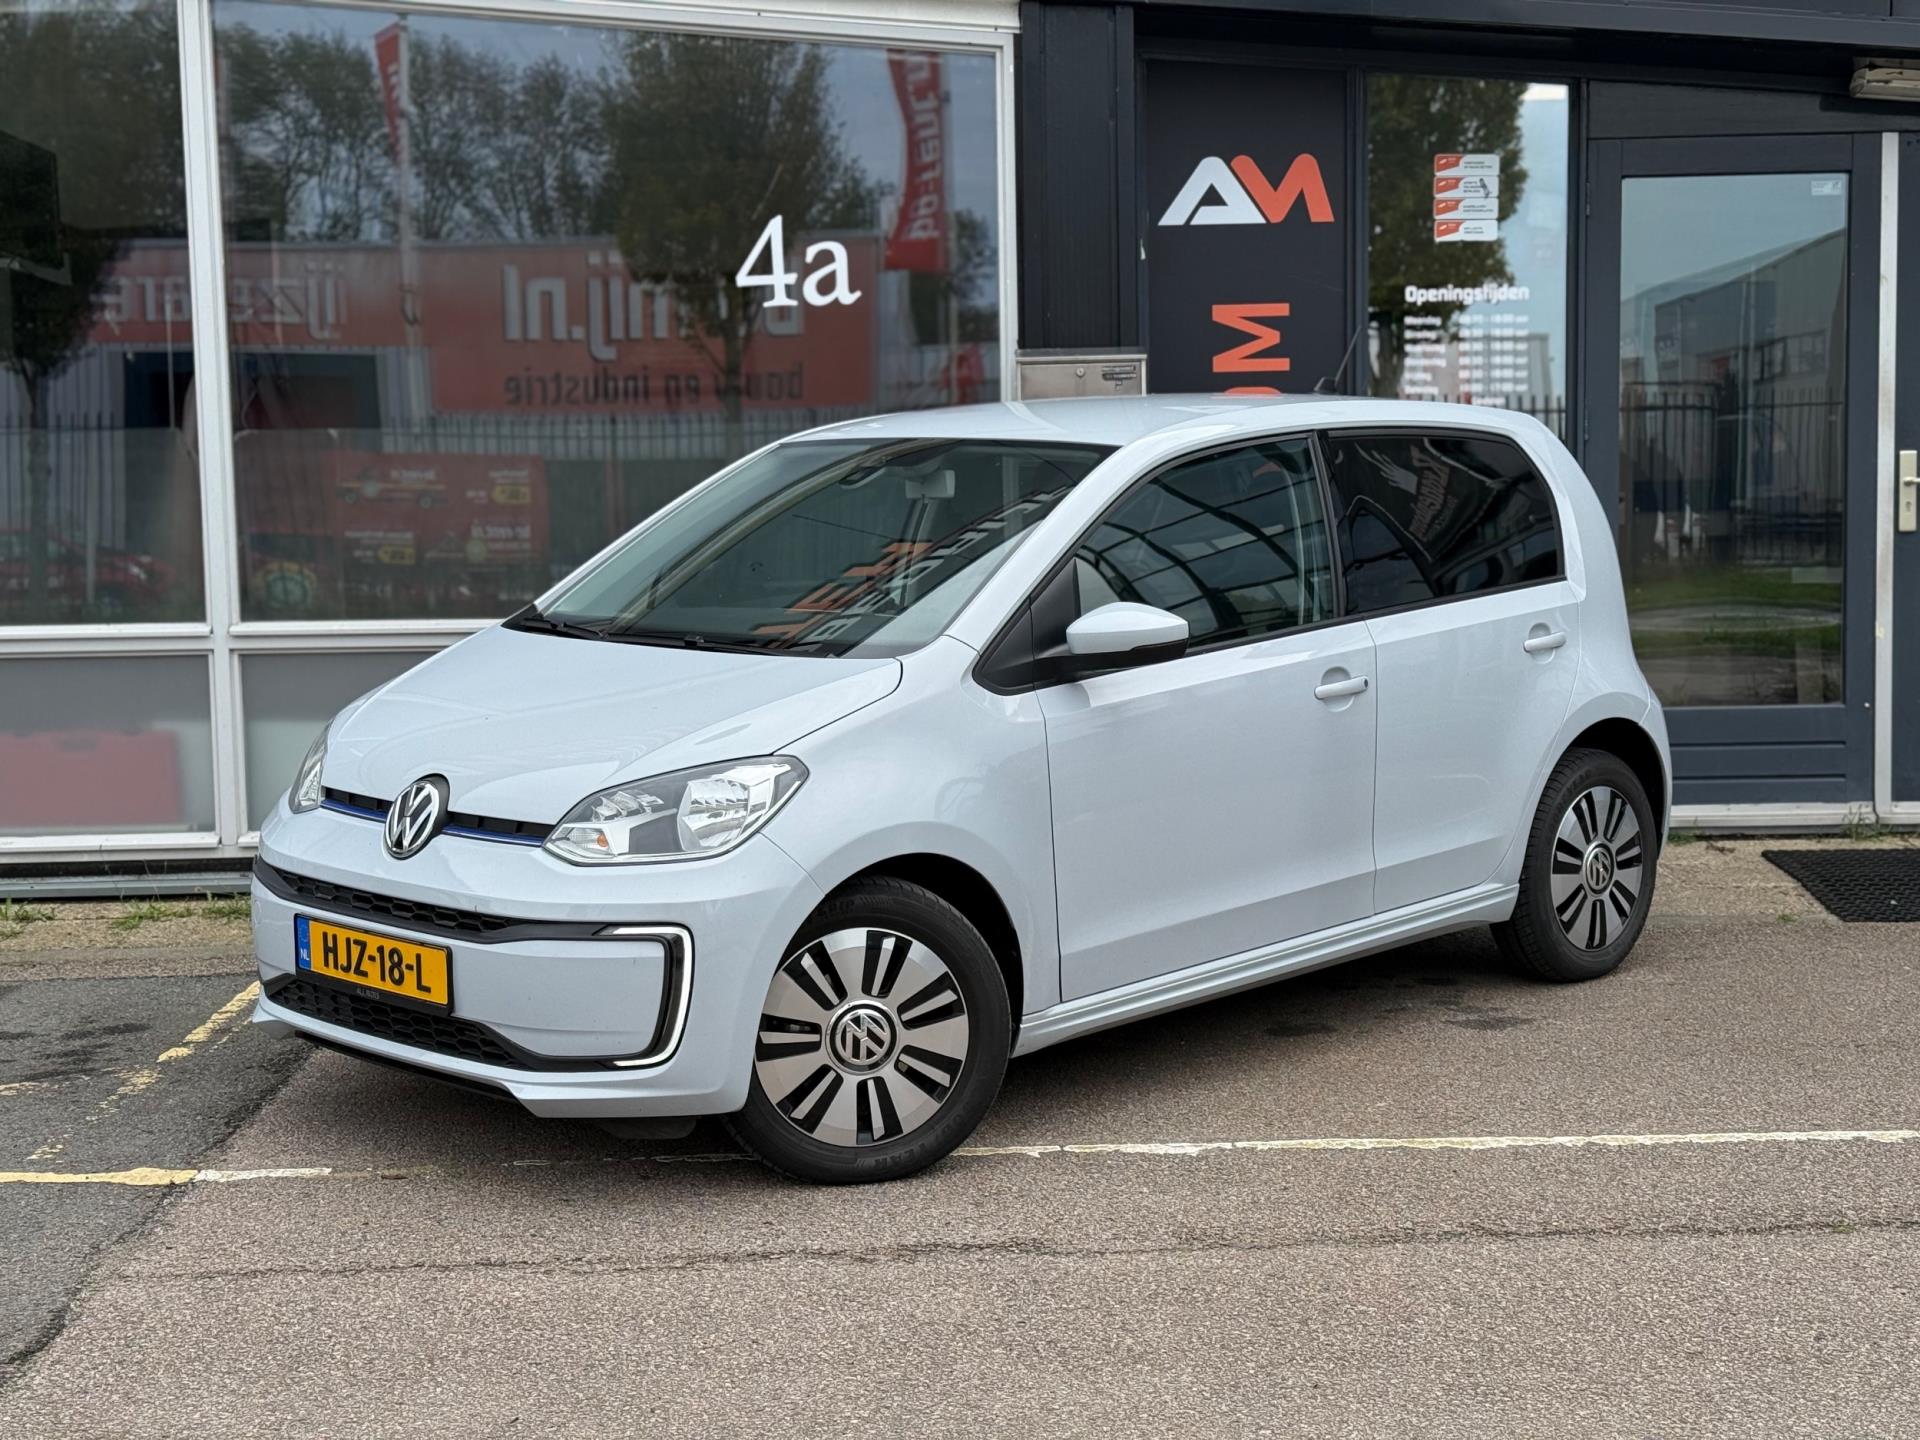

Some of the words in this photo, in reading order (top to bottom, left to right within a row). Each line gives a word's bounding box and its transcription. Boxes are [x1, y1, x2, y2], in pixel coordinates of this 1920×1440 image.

[1157, 153, 1335, 226] AM
[735, 214, 862, 308] 4a
[1404, 283, 1530, 306] Openingstijden
[300, 948, 310, 961] NL
[322, 931, 432, 994] HJZ-18-L
